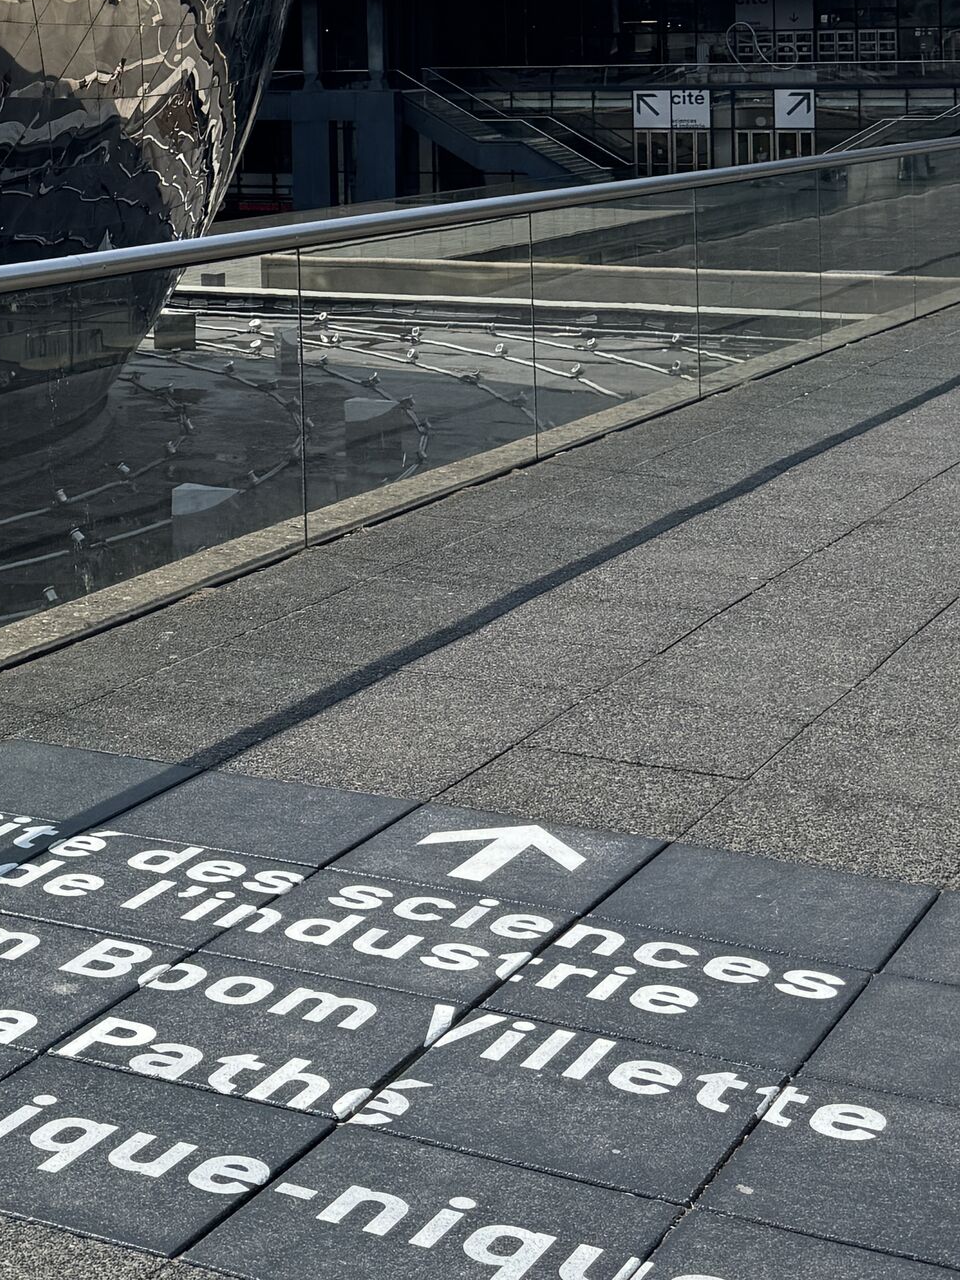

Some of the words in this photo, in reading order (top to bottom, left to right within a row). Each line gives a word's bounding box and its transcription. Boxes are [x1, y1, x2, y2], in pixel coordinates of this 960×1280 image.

[672, 90, 705, 105] cité
[119, 879, 699, 1015] l'industrie
[127, 847, 305, 895] des
[328, 884, 846, 1000] sciences
[56, 1016, 433, 1125] Pathé
[58, 938, 378, 1030] Boom
[423, 1004, 887, 1141] Villette
